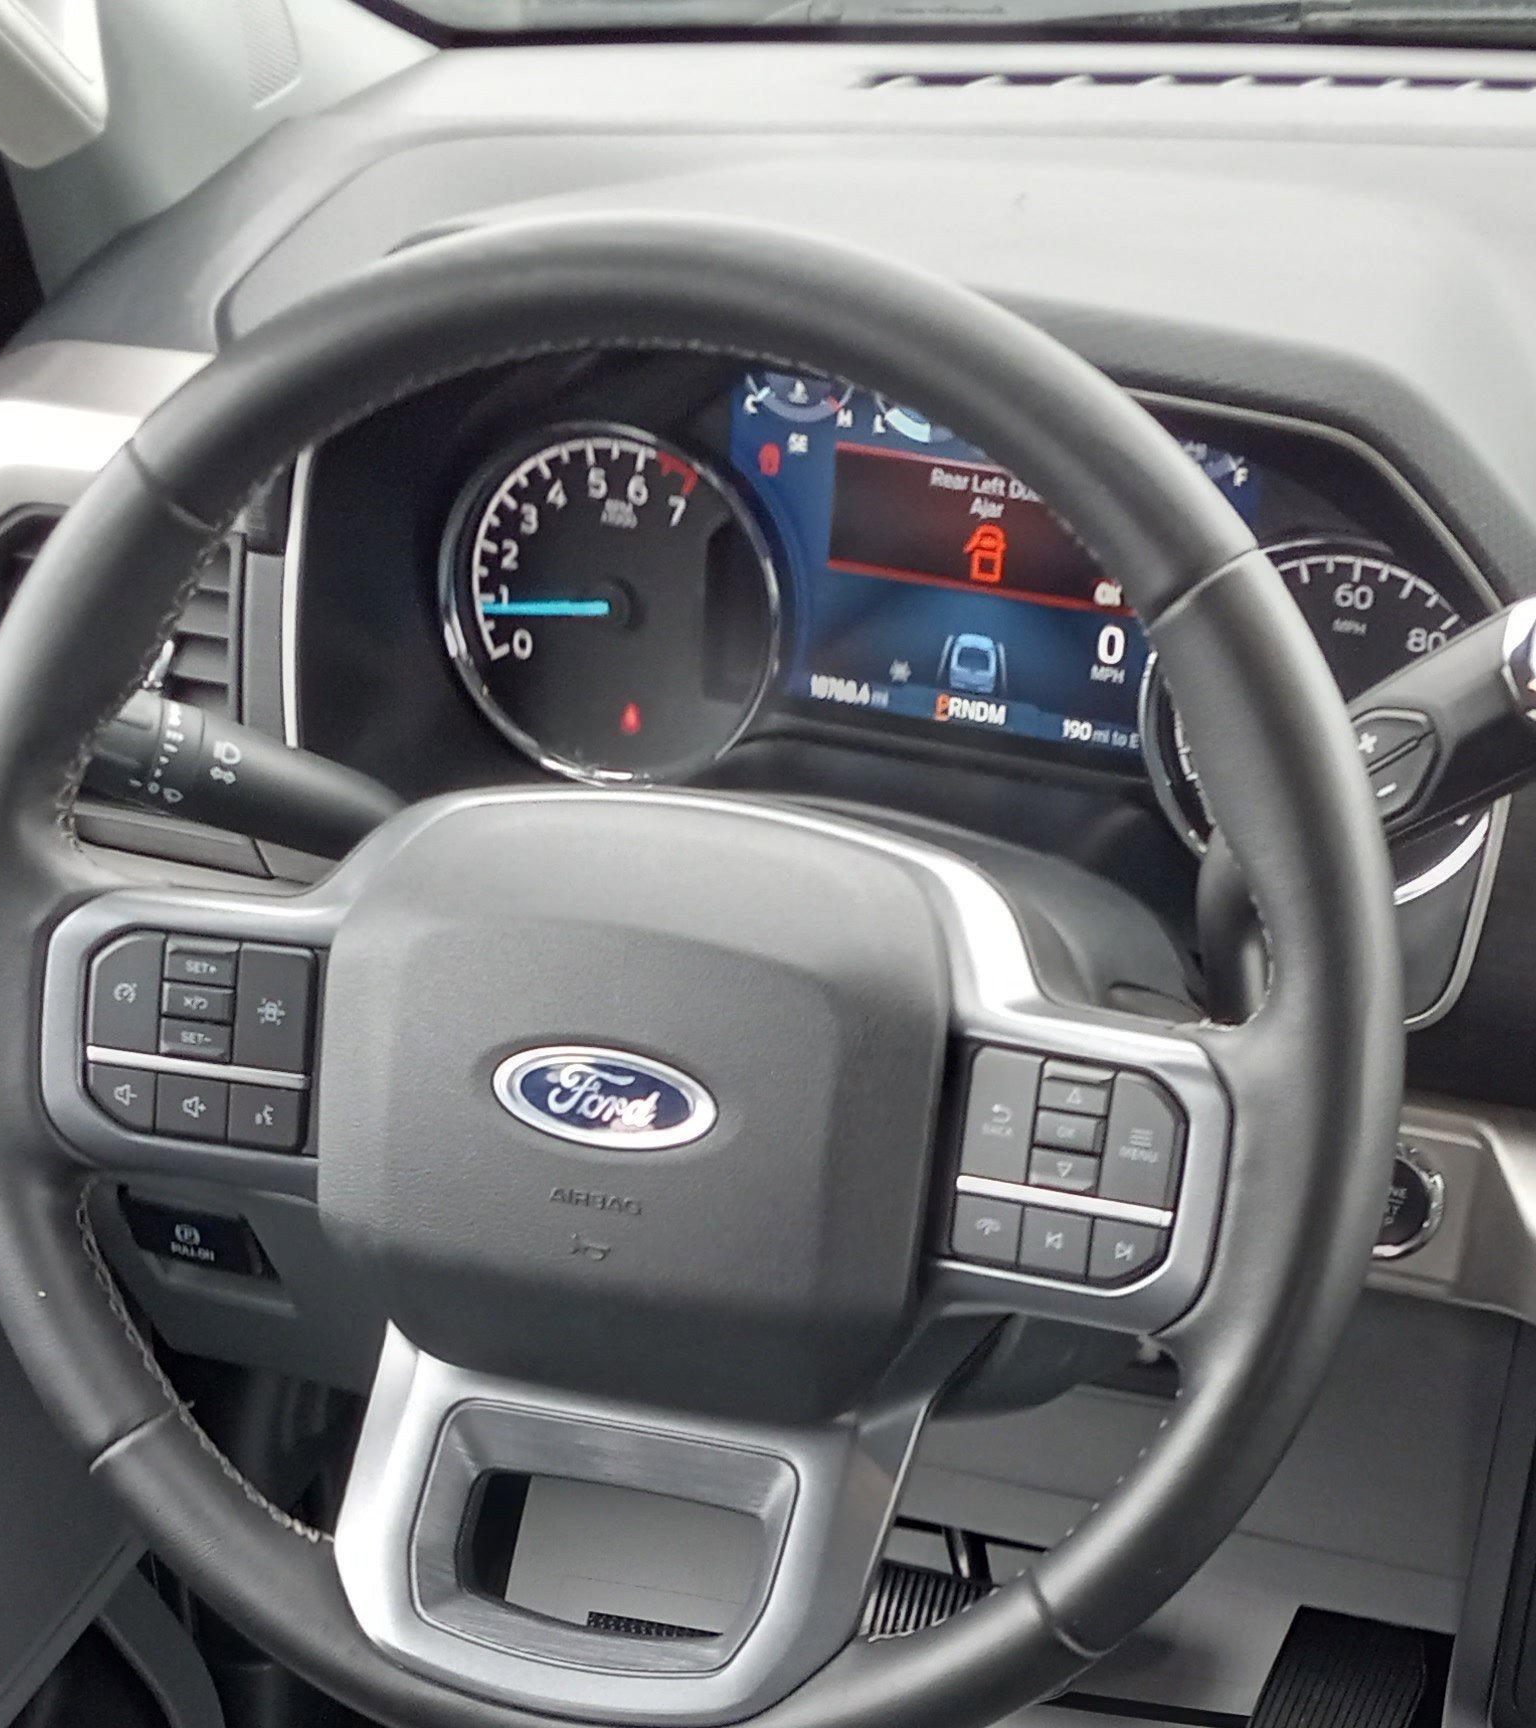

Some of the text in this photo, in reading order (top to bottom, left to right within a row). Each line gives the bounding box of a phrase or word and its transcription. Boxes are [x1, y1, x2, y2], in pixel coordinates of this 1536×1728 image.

[546, 479, 568, 509] 4
[587, 467, 608, 499] 5
[627, 474, 649, 506] 6
[519, 504, 539, 535] 3
[667, 494, 687, 527] 7
[500, 539, 519, 570] 2
[1334, 583, 1375, 610] 60
[513, 629, 533, 660] 0
[1098, 624, 1125, 665] 0
[1406, 628, 1449, 653] 80
[1090, 664, 1125, 684] MPH
[1062, 718, 1093, 741] 190
[546, 1062, 662, 1128] Ford
